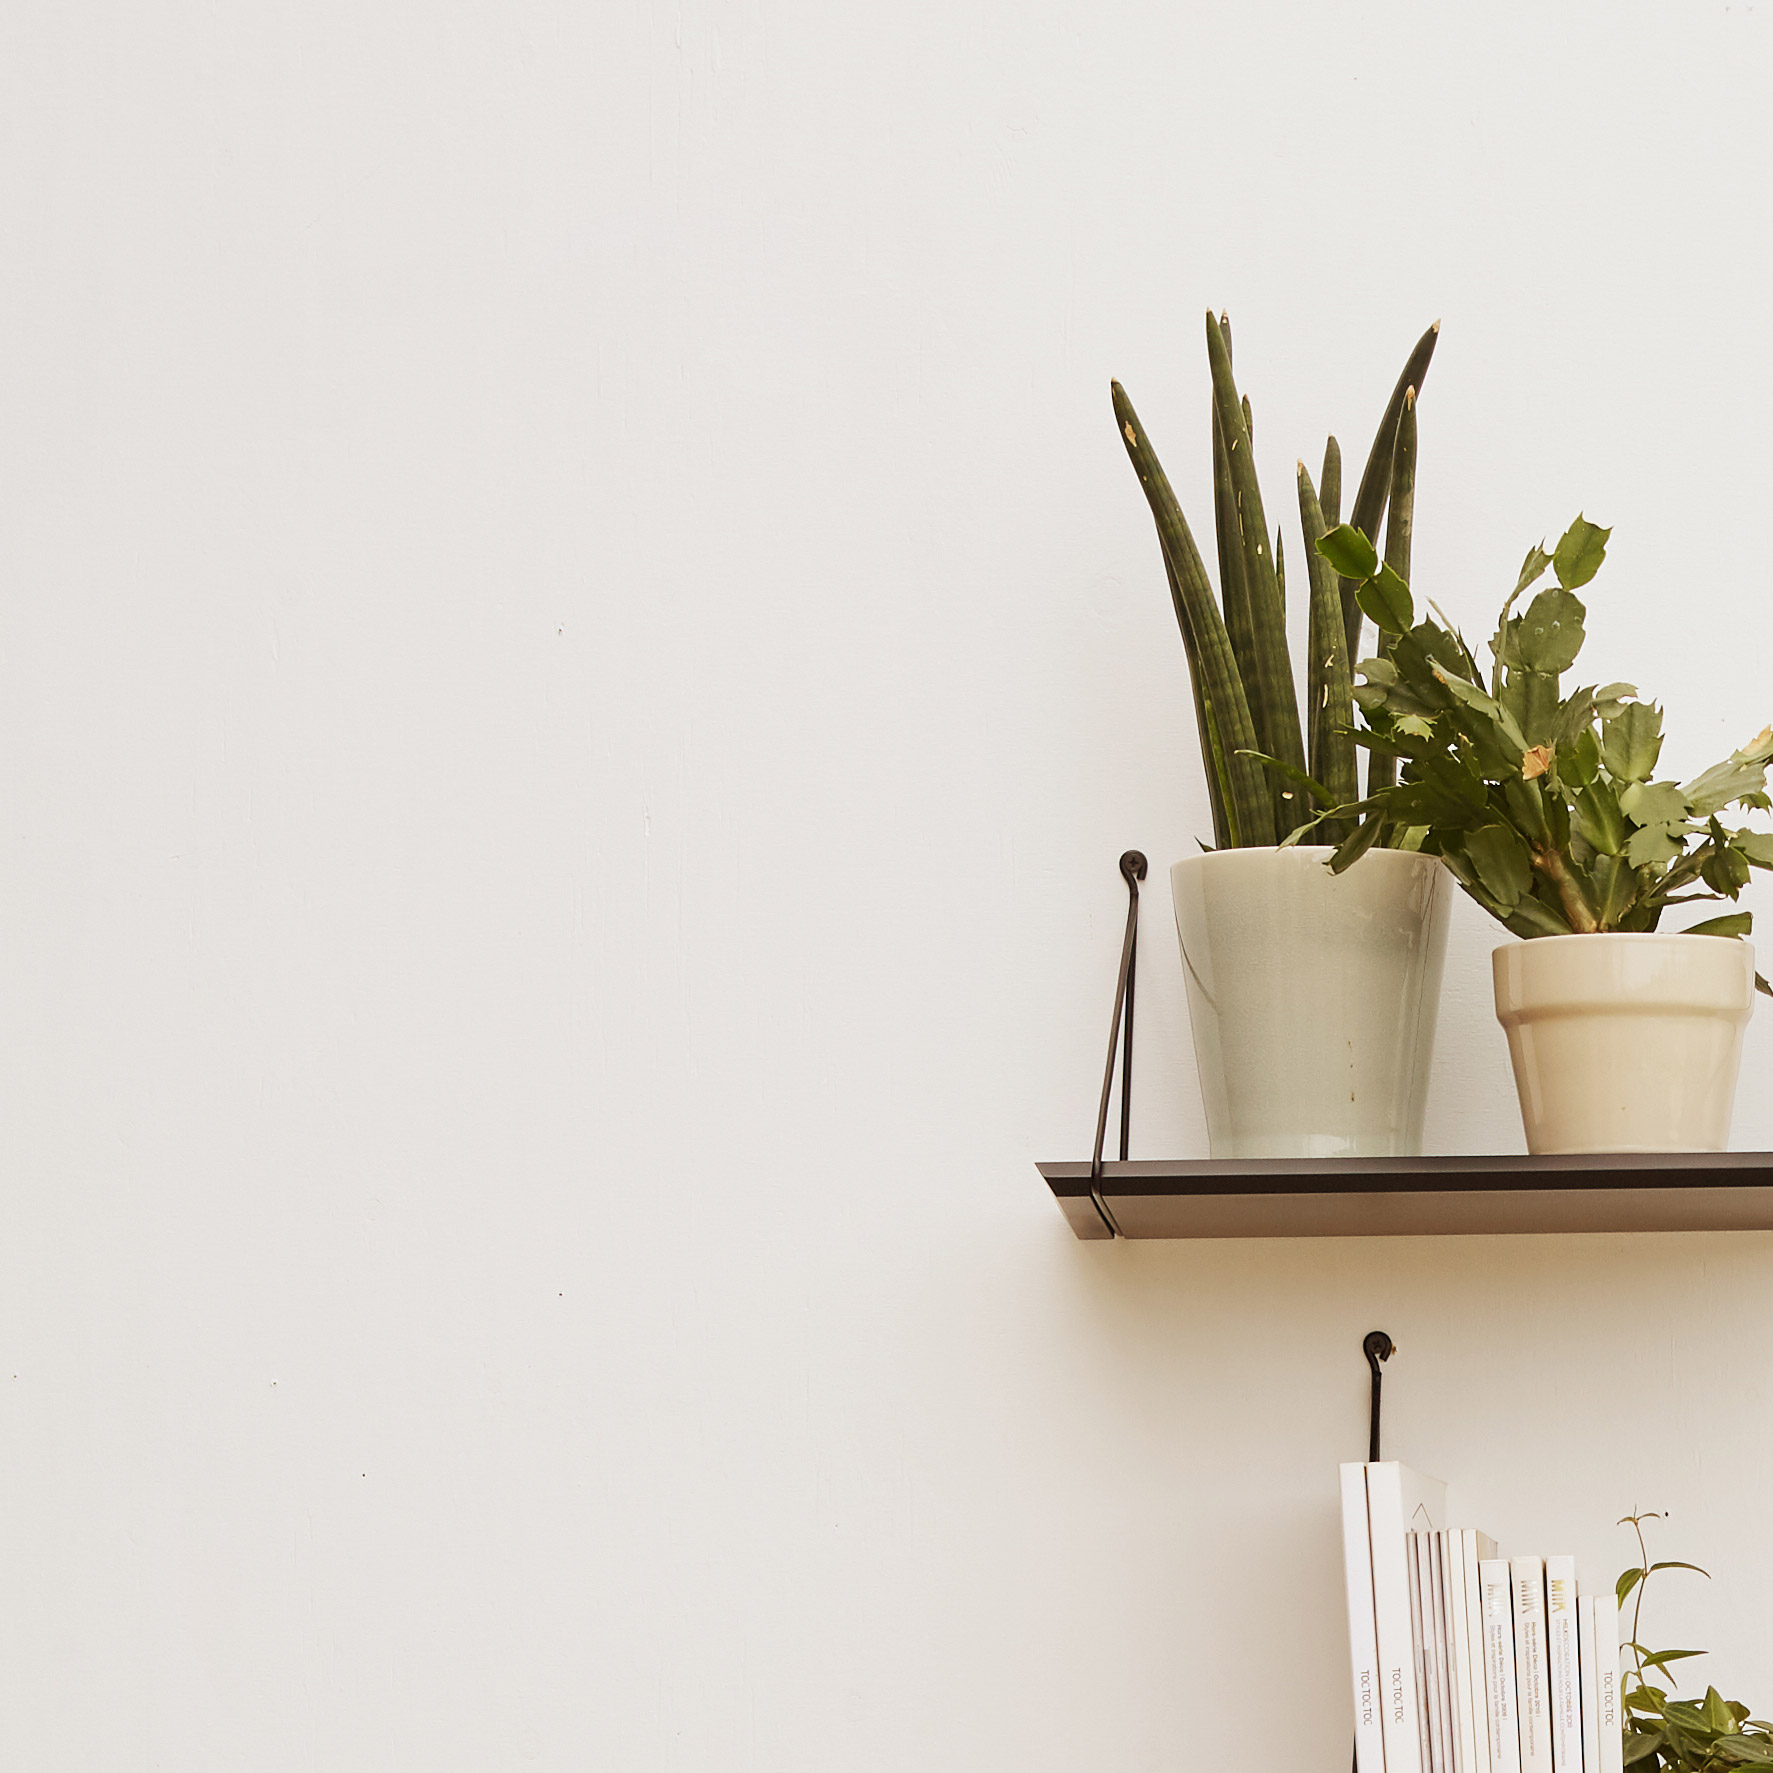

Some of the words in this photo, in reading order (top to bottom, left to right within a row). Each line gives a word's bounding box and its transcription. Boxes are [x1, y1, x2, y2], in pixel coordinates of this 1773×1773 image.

[1360, 1670, 1370, 1688] TOC
[1392, 1668, 1402, 1686] TOC
[1604, 1670, 1612, 1688] TOC
[1362, 1689, 1371, 1706] TOC
[1394, 1686, 1402, 1704] TOC
[1564, 1681, 1572, 1712] OCTOBRE
[1604, 1690, 1613, 1708] TOC
[1363, 1708, 1372, 1725] TOC
[1395, 1705, 1404, 1724] TOC
[1606, 1708, 1614, 1726] TOC
